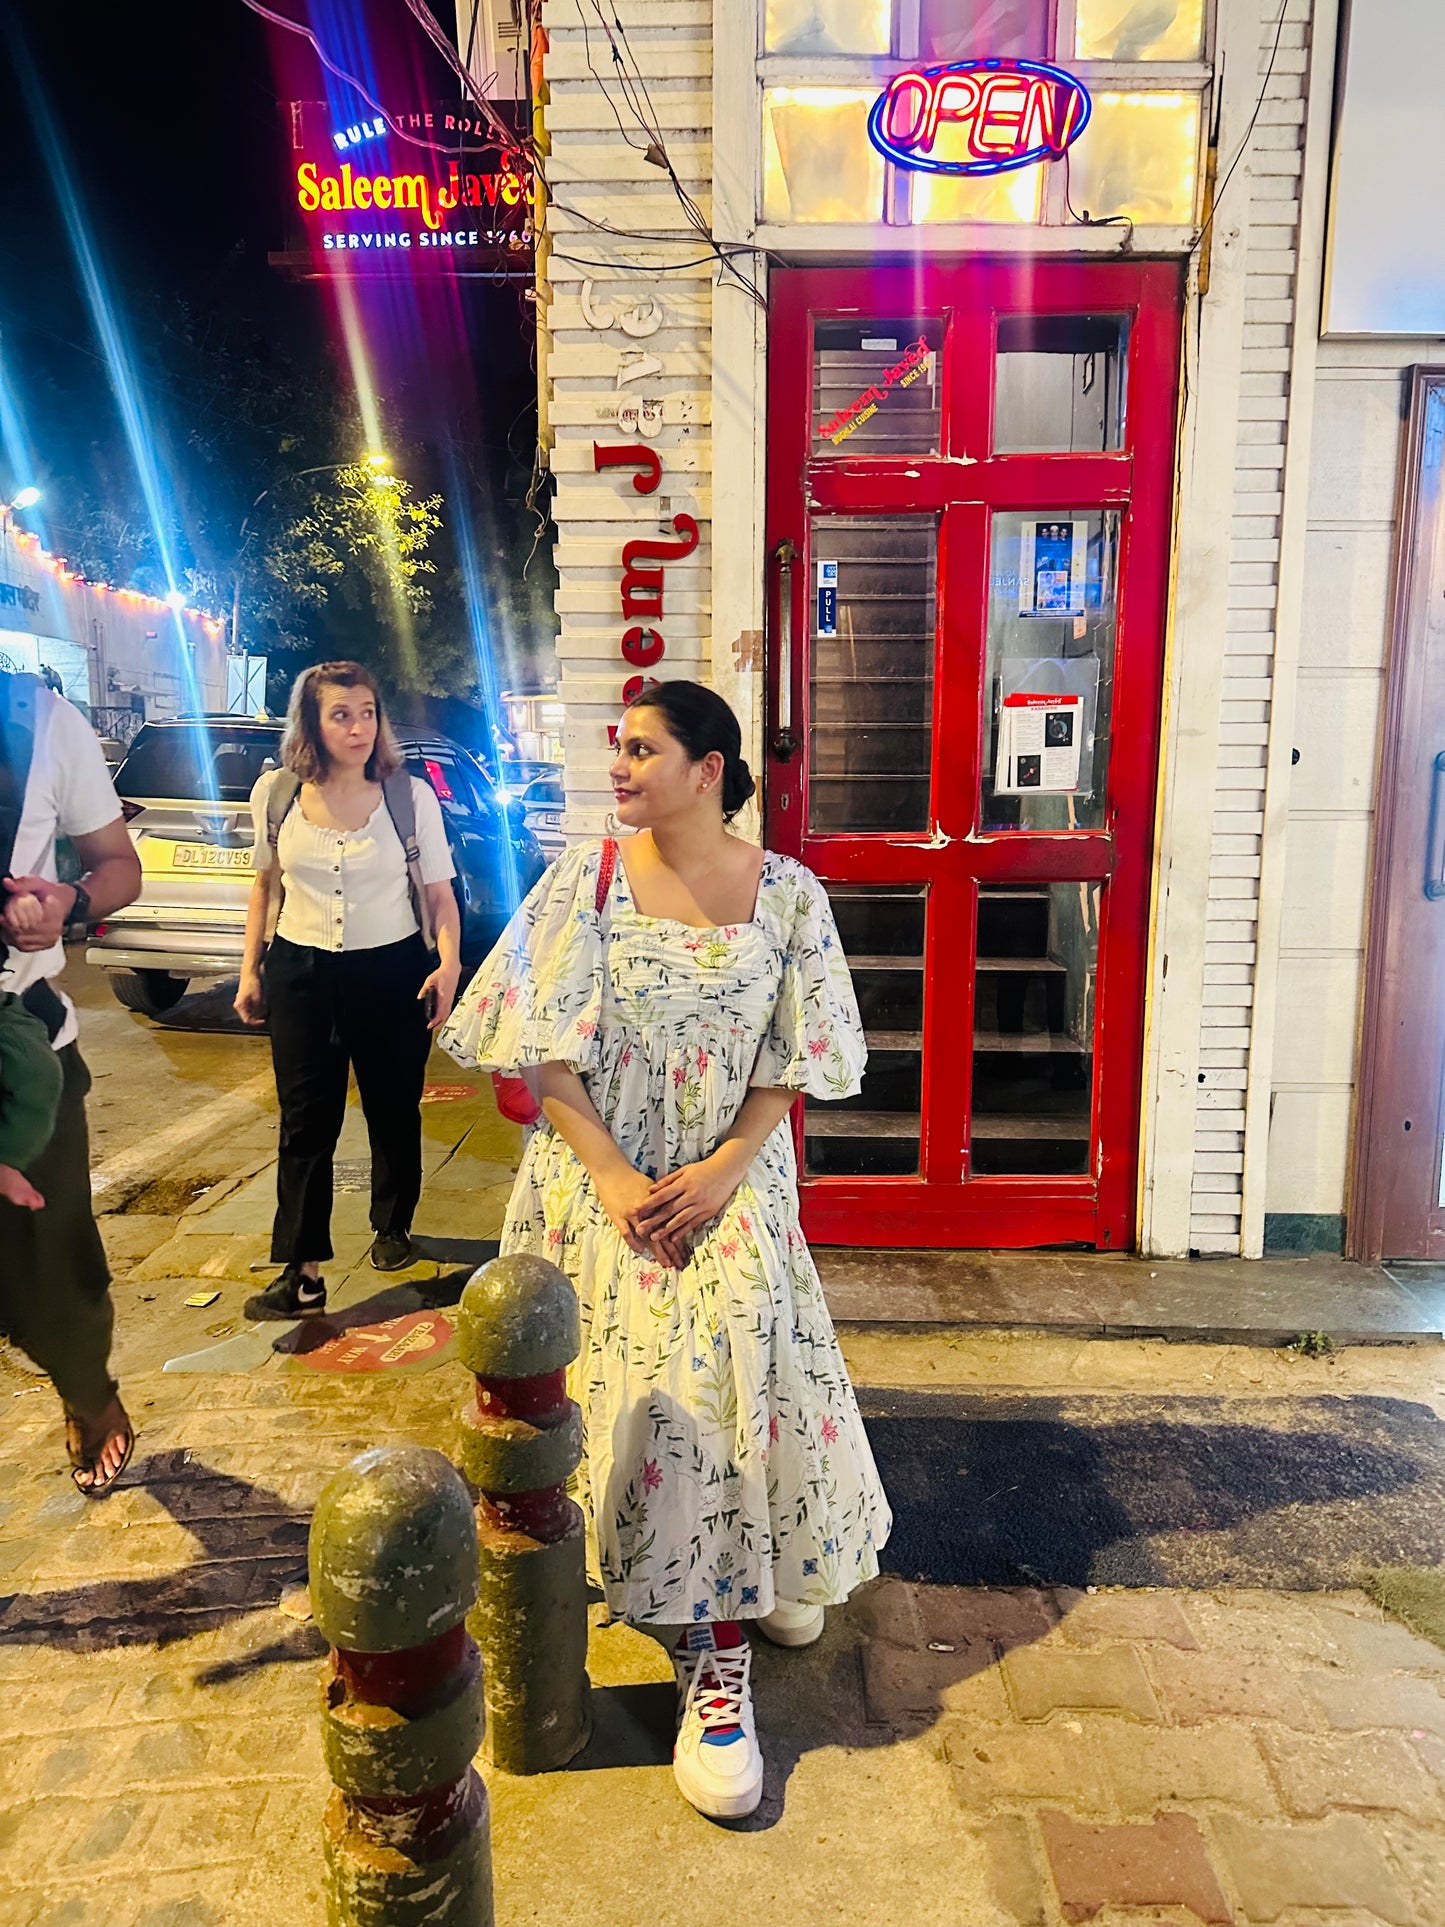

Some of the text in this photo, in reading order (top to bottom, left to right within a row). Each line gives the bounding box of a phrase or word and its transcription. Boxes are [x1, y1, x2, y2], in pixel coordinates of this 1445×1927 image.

[881, 72, 1079, 158] OPEN
[333, 117, 387, 150] RULE
[396, 113, 433, 128] THE
[297, 162, 443, 229] Saleem
[323, 231, 411, 249] SERVING
[419, 230, 478, 246] SINCE
[817, 335, 931, 440] Saleem Javed
[900, 369, 920, 388] SINCE
[855, 403, 879, 425] CUISINE
[336, 1346, 369, 1365] WAY
